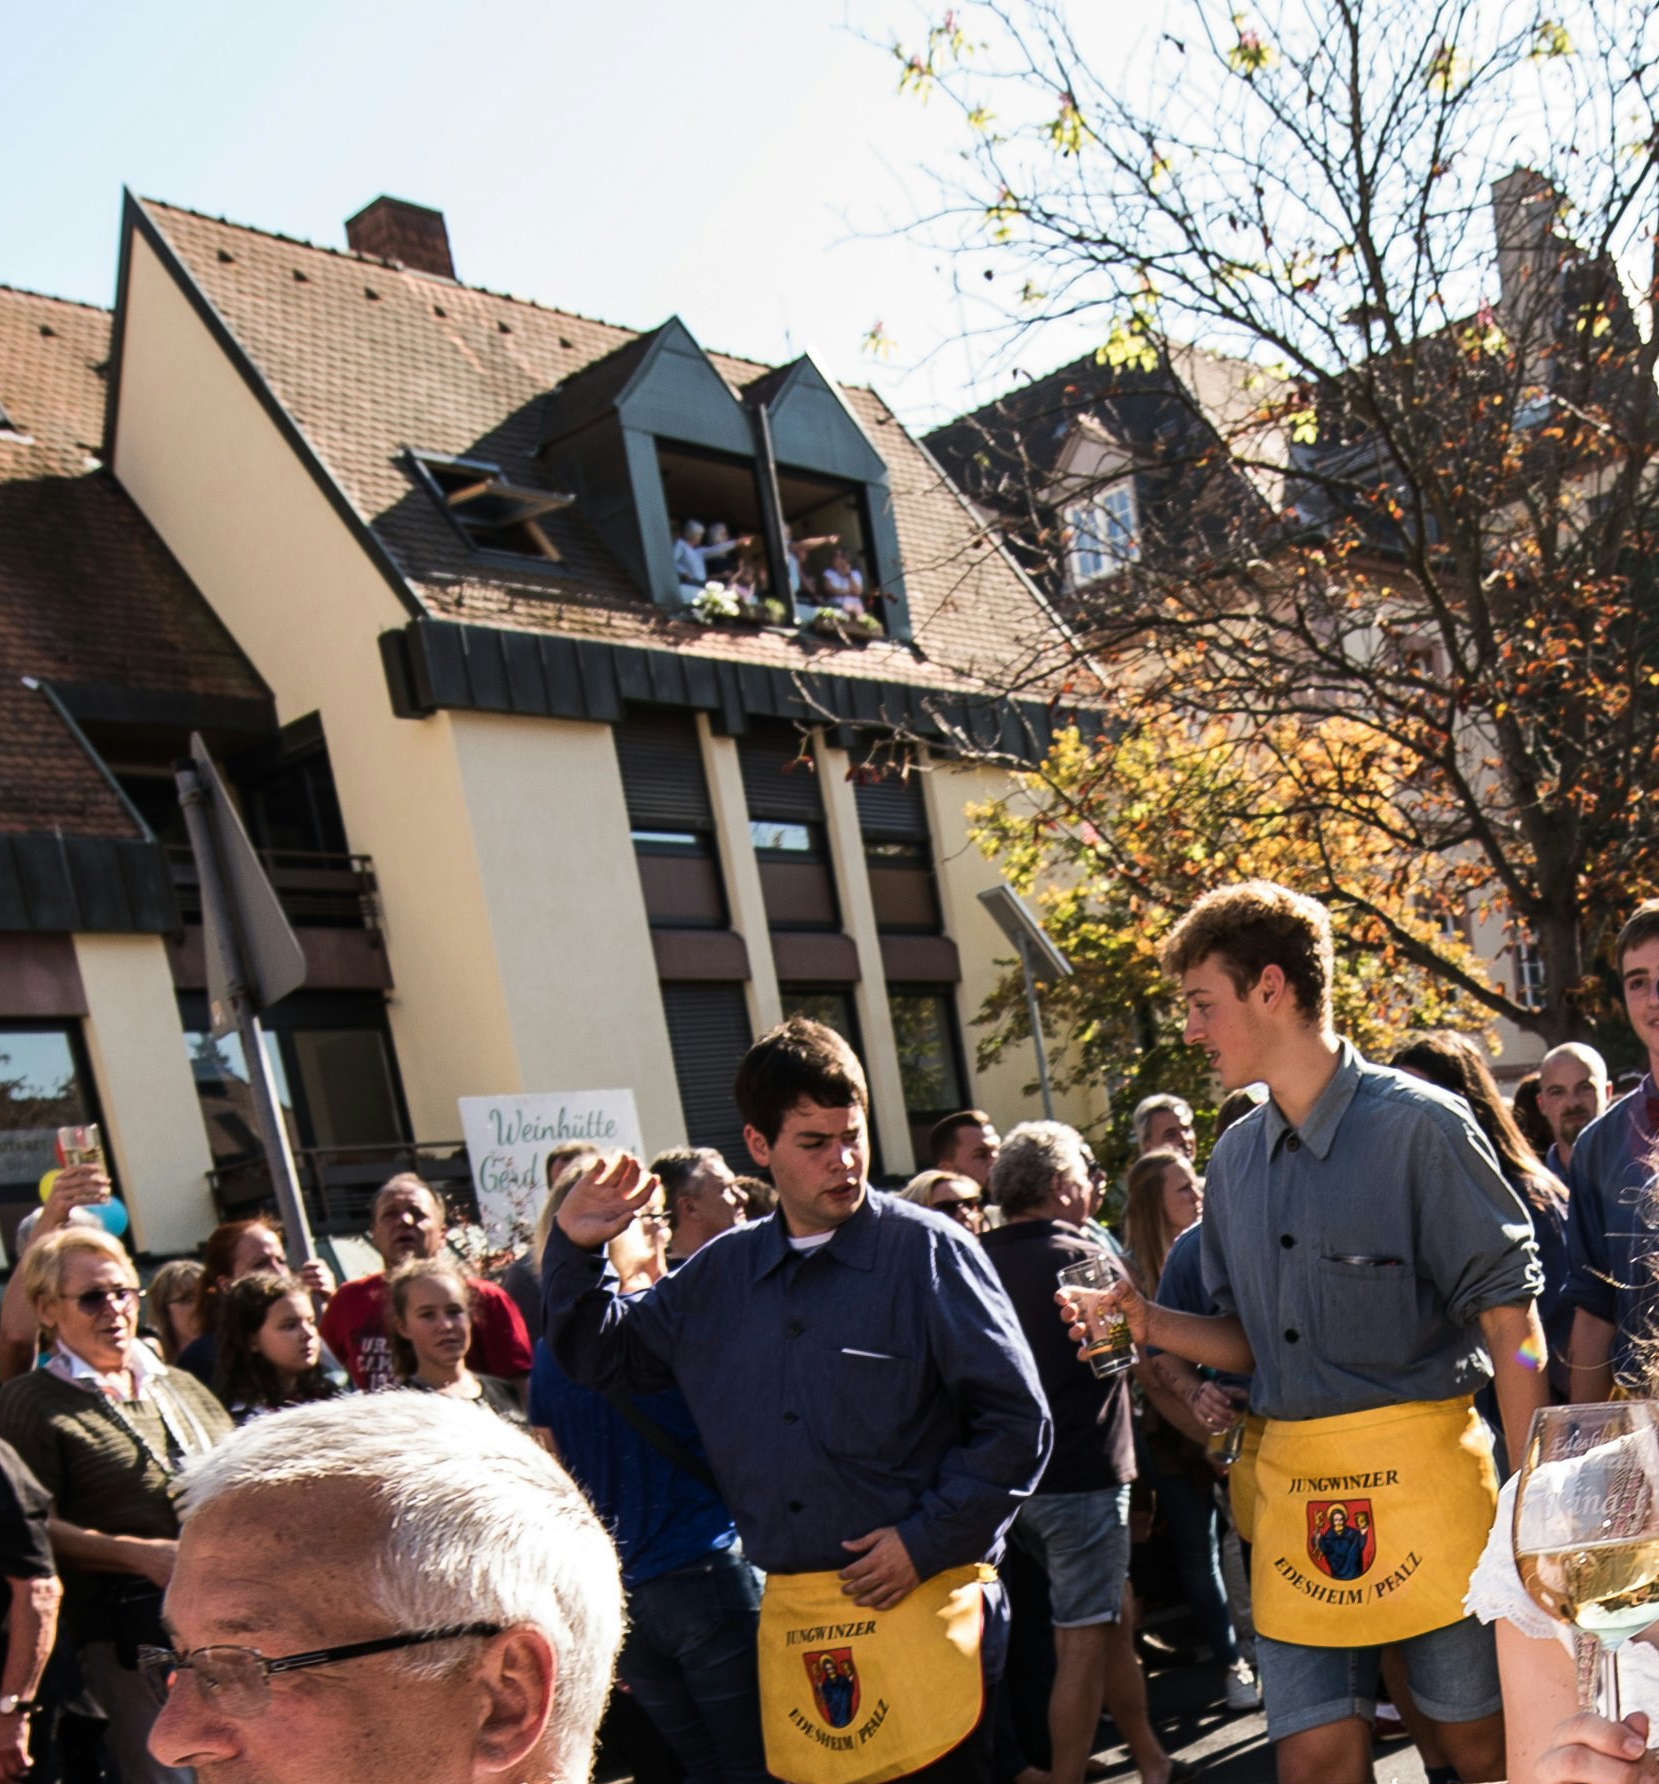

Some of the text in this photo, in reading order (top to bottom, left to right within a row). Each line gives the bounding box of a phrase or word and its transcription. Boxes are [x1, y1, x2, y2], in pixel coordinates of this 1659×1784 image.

[489, 1106, 618, 1146] Weinhütte
[1288, 1470, 1399, 1494] JUNGWINZER
[1374, 1551, 1422, 1598] PFALZ
[786, 1620, 876, 1647] JUNGWINZER
